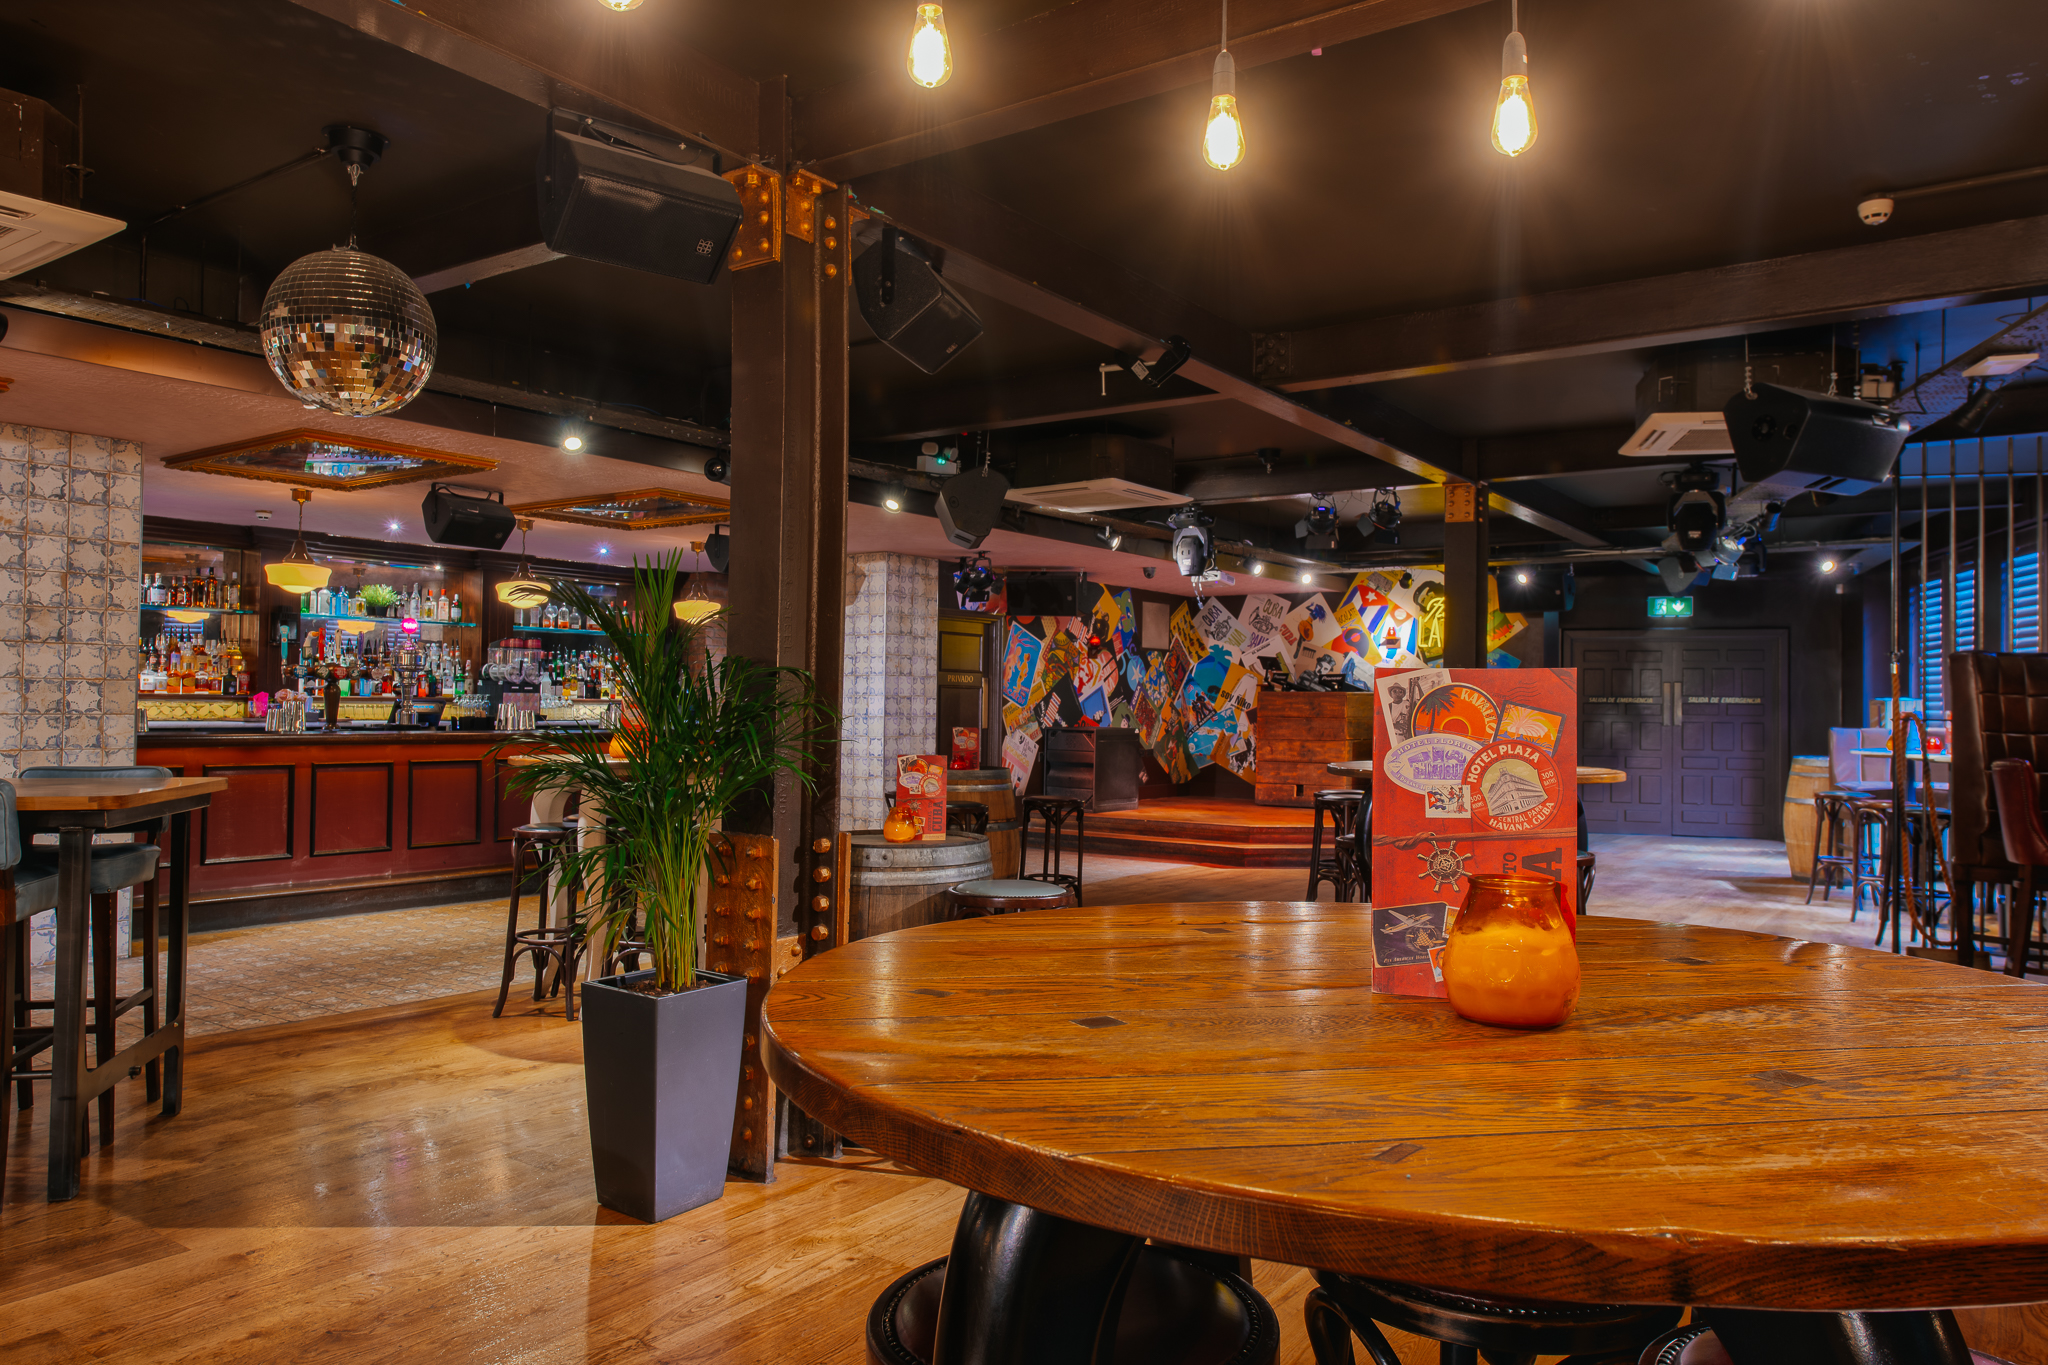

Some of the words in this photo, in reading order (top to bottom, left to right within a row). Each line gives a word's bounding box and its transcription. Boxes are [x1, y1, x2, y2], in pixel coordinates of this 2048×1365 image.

[1201, 604, 1223, 627] CUBA
[1262, 598, 1284, 620] CUBA
[1279, 623, 1298, 646] CUBA
[947, 674, 974, 683] PRIVADO
[1397, 740, 1431, 755] HOTEL
[1467, 749, 1497, 783] HOTEL
[1498, 744, 1540, 764] PLAZA
[1541, 770, 1554, 779] 300
[932, 800, 944, 832] CUBA
[1498, 812, 1528, 823] CENTRAL
[1527, 804, 1544, 818] PARK
[1532, 801, 1555, 825] CUBA
[1502, 852, 1517, 874] TO
